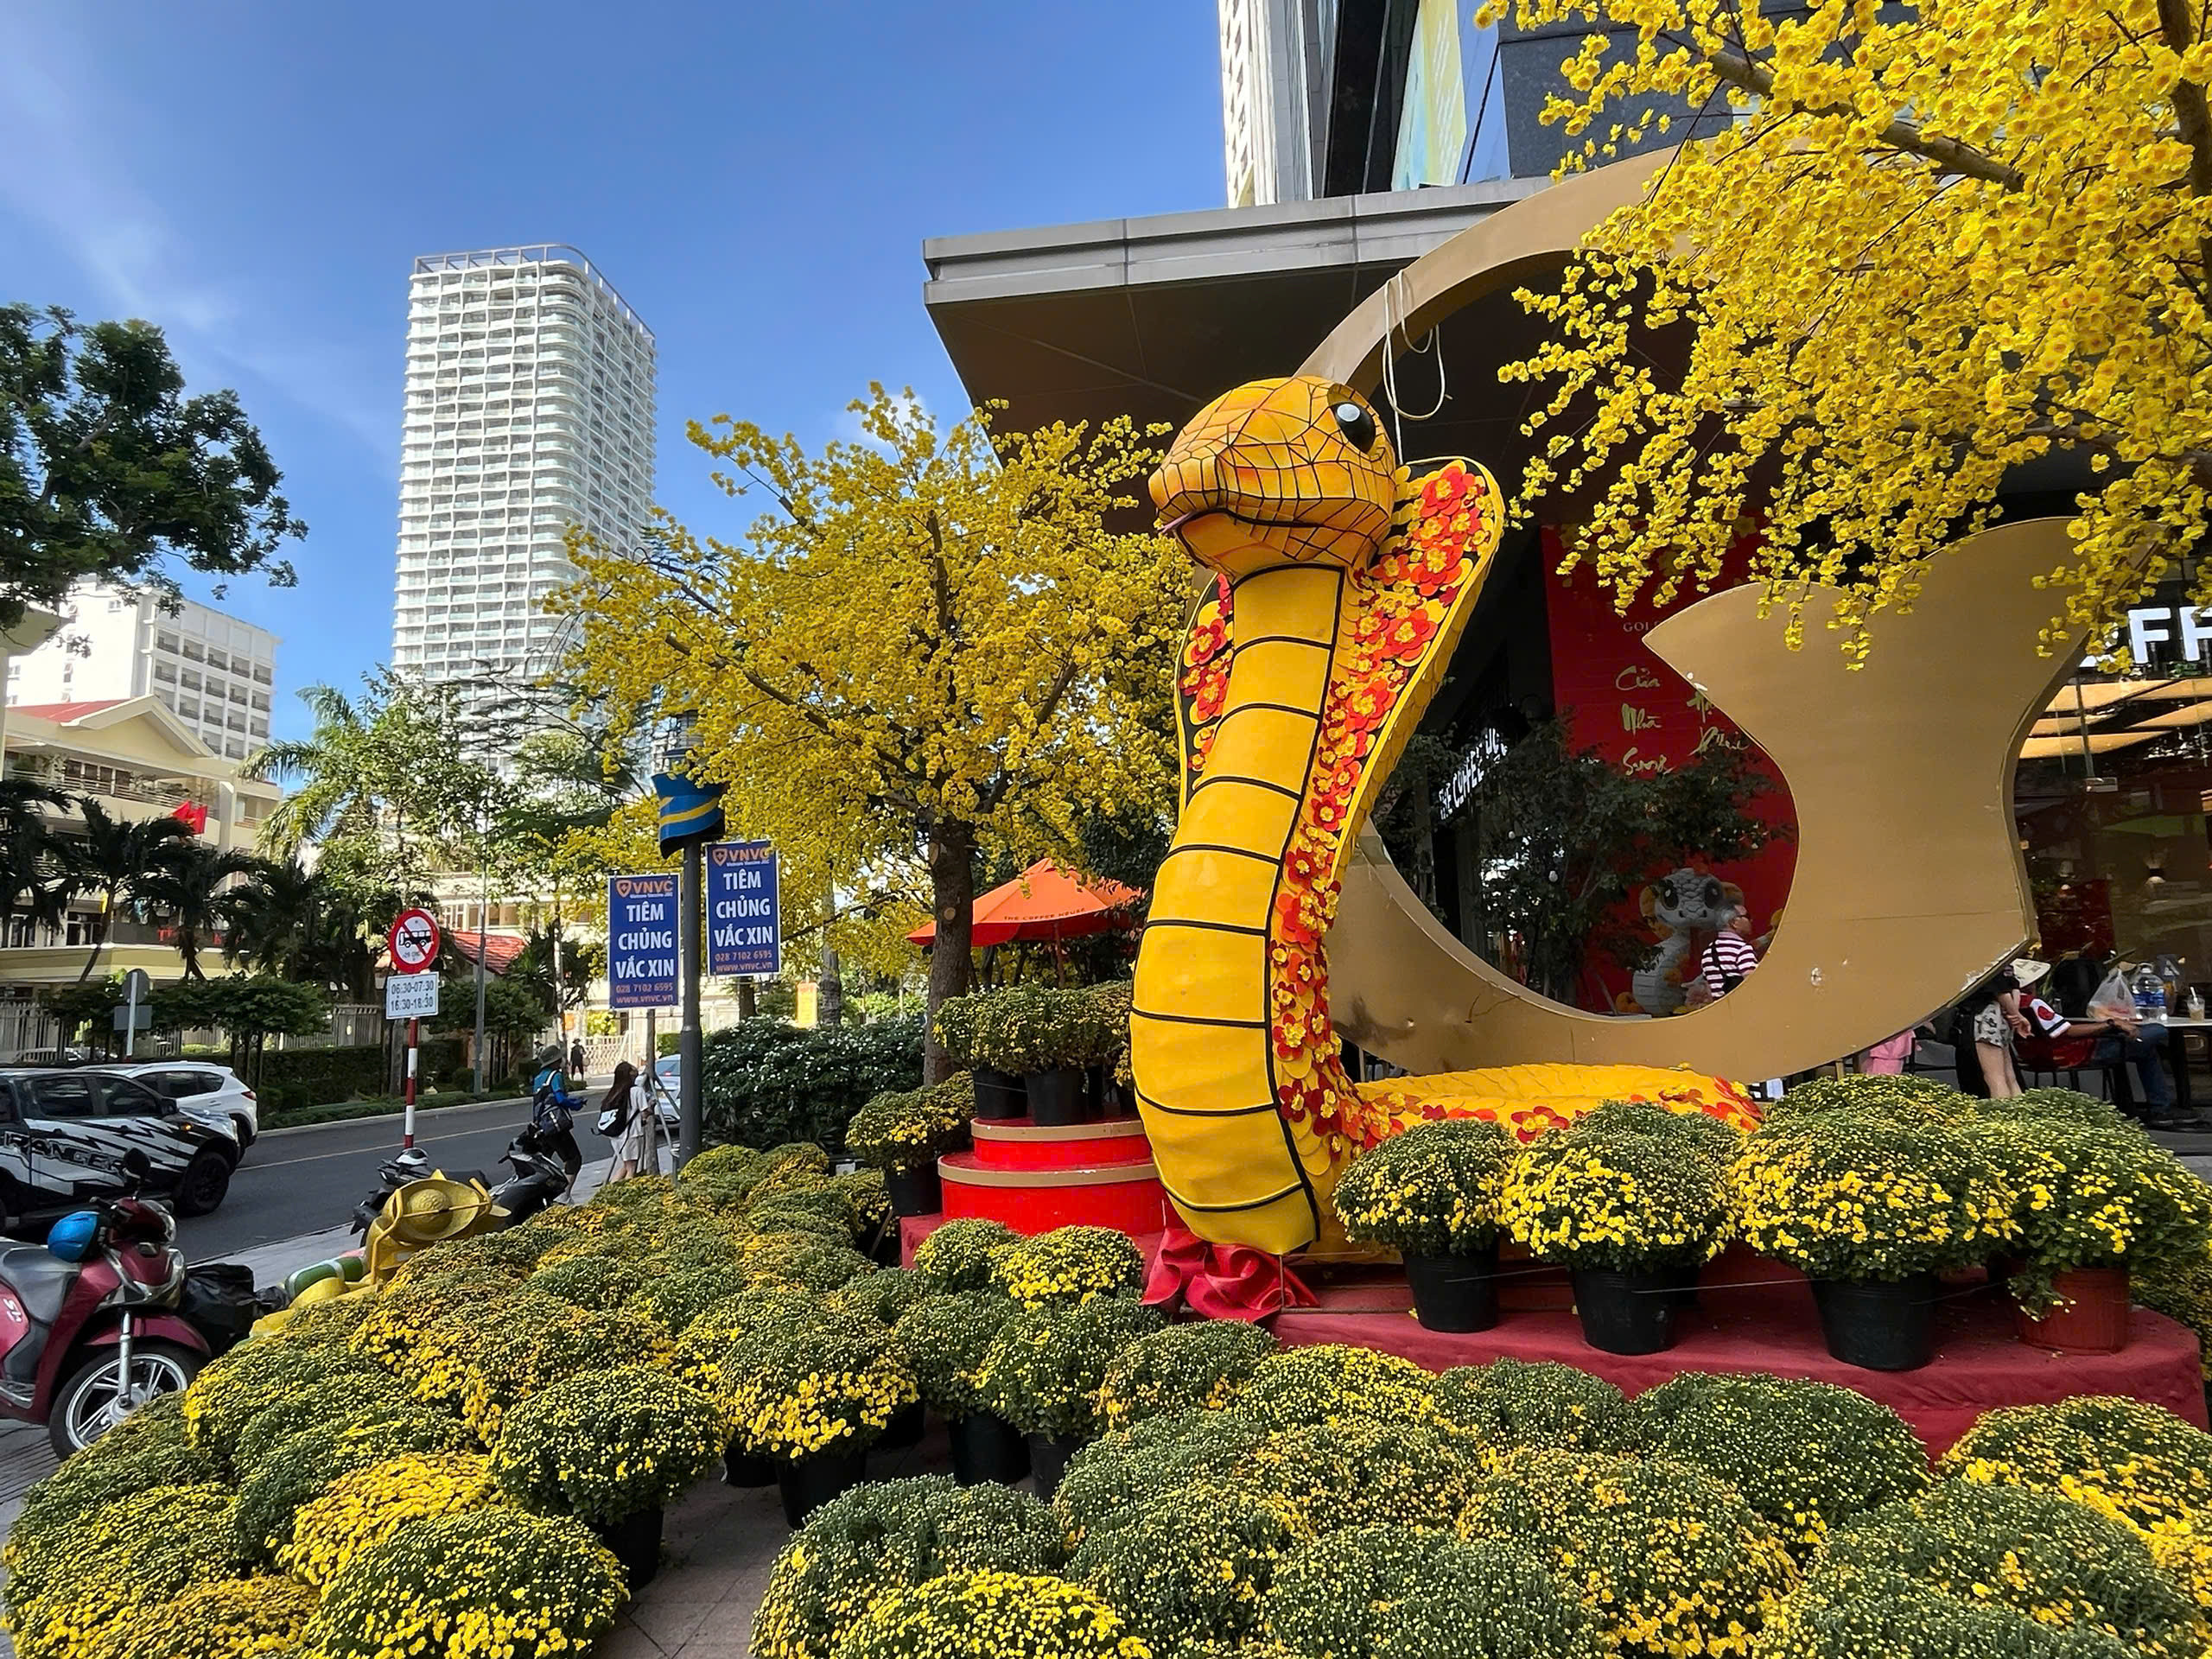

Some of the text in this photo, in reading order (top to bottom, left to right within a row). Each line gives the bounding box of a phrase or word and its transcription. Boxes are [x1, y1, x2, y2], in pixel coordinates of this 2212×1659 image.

[729, 848, 769, 861] VNVC
[632, 880, 674, 893] VNVC
[723, 868, 761, 890] TIÊM
[626, 900, 664, 922] TIÊM
[716, 895, 771, 918] CHỦNG
[618, 927, 672, 950] CHỦNG
[714, 924, 773, 947] VẮC XIN
[615, 955, 674, 978] VẮC XIN
[715, 953, 730, 962] 028
[733, 951, 752, 961] 7102
